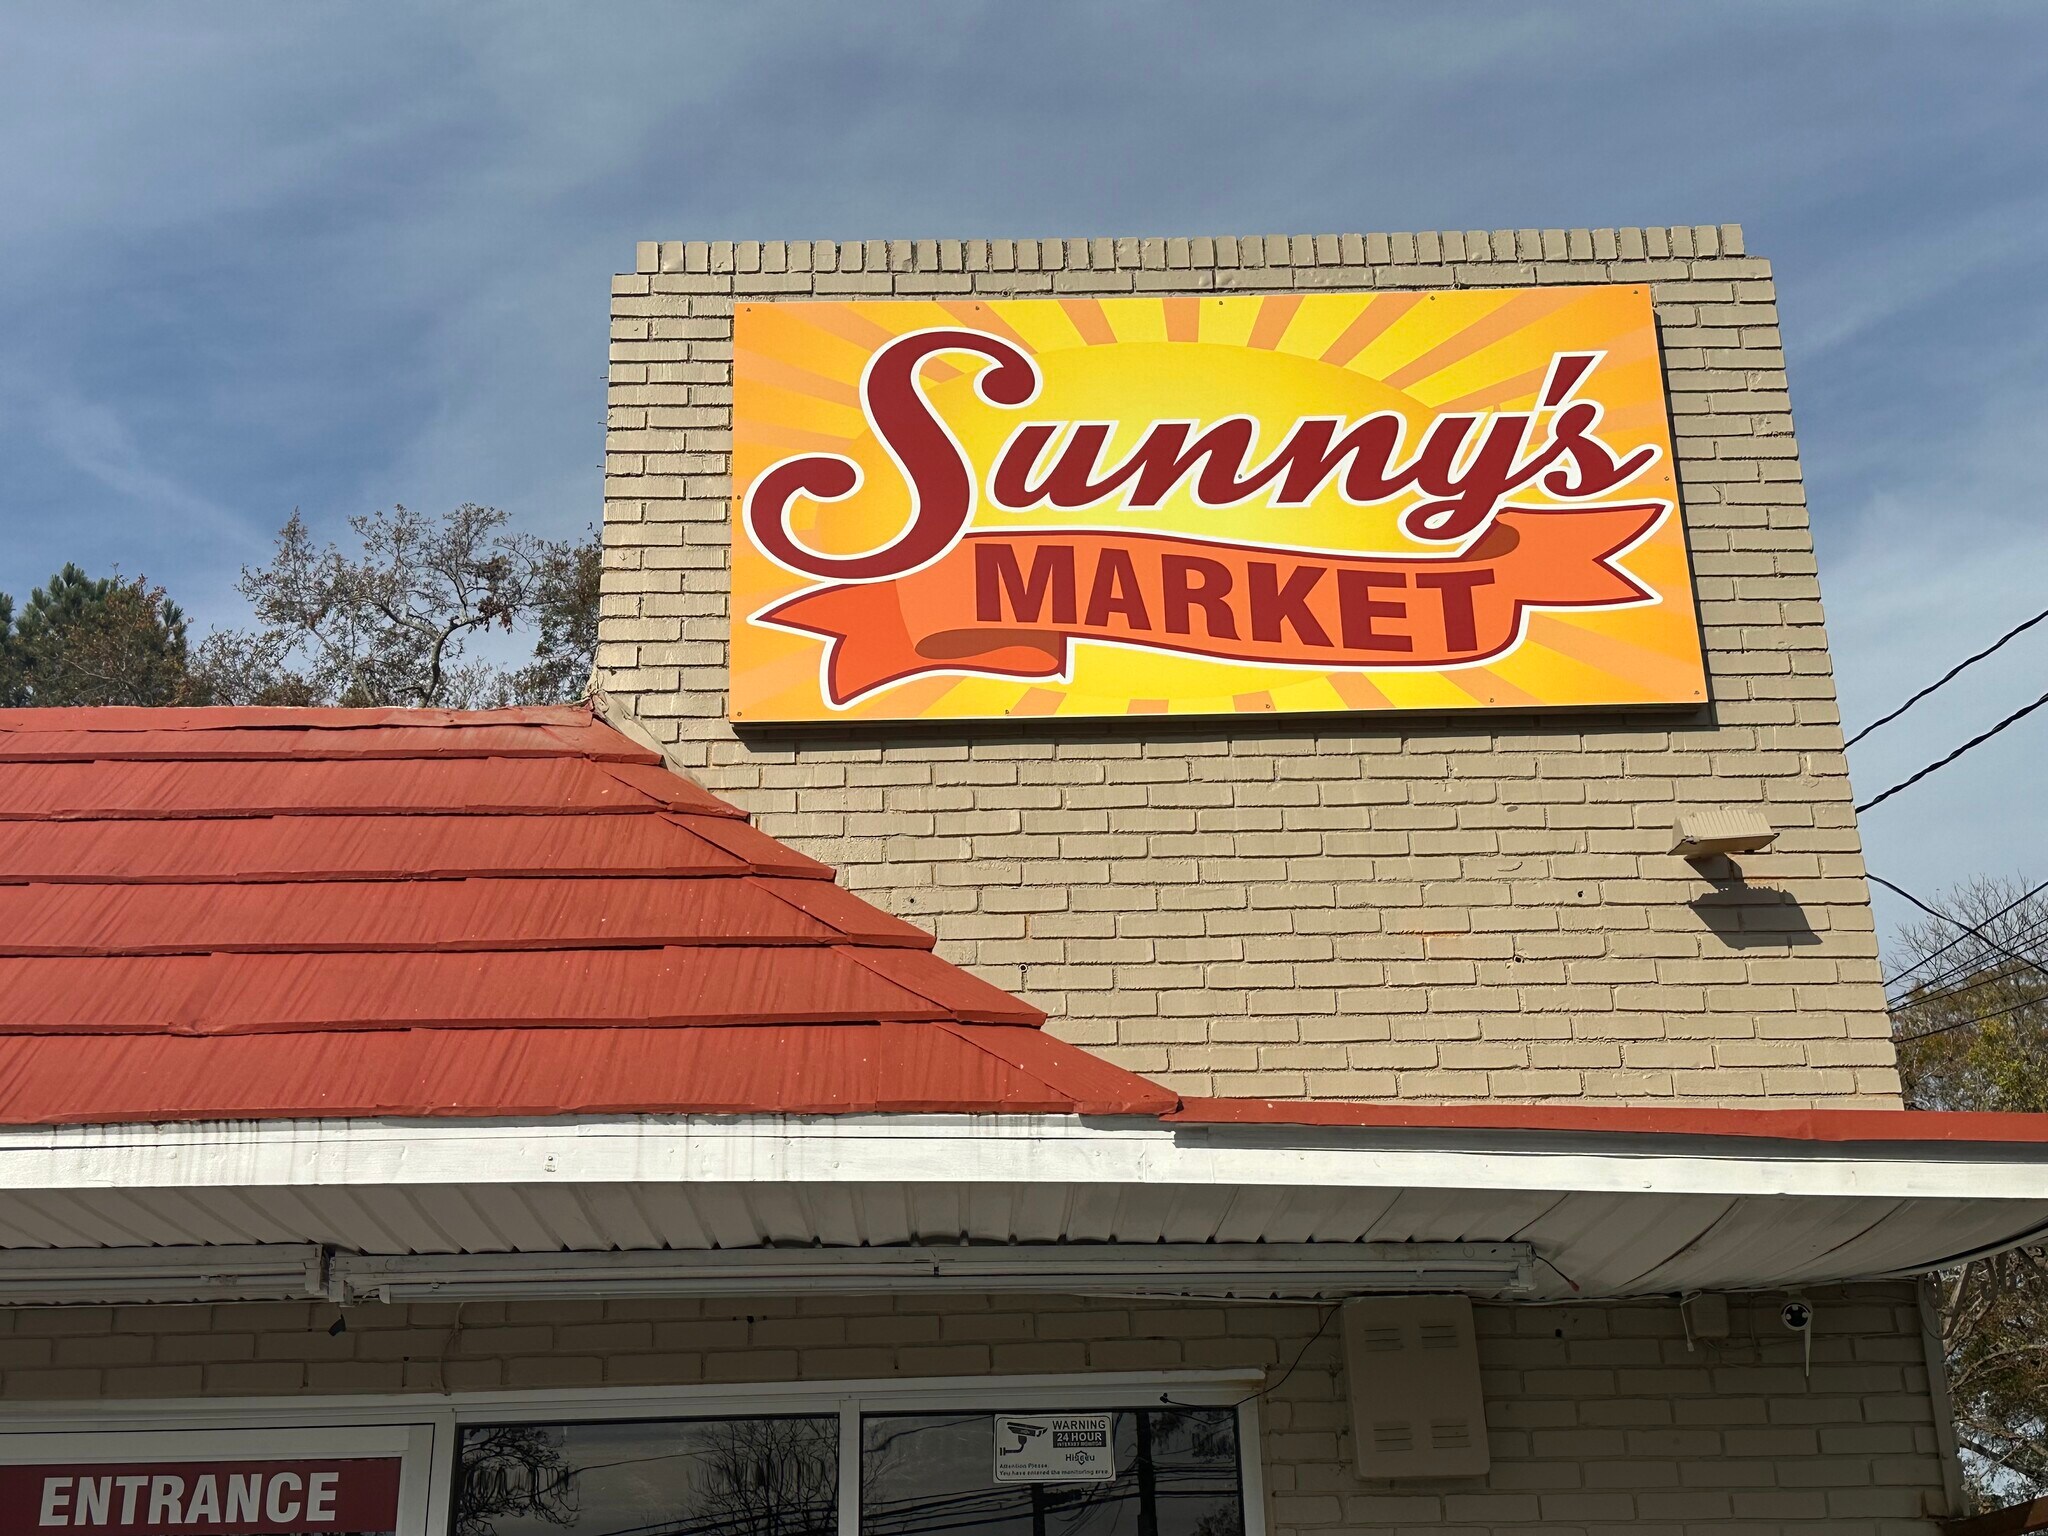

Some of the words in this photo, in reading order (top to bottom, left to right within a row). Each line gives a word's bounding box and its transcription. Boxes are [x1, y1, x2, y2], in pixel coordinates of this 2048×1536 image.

[750, 331, 1654, 579] Sunny's
[974, 543, 1496, 653] MARKET
[1052, 1419, 1106, 1430] WARNING
[1056, 1432, 1069, 1442] 24
[1071, 1432, 1102, 1442] HOUR
[38, 1471, 339, 1527] ENTRANCE
